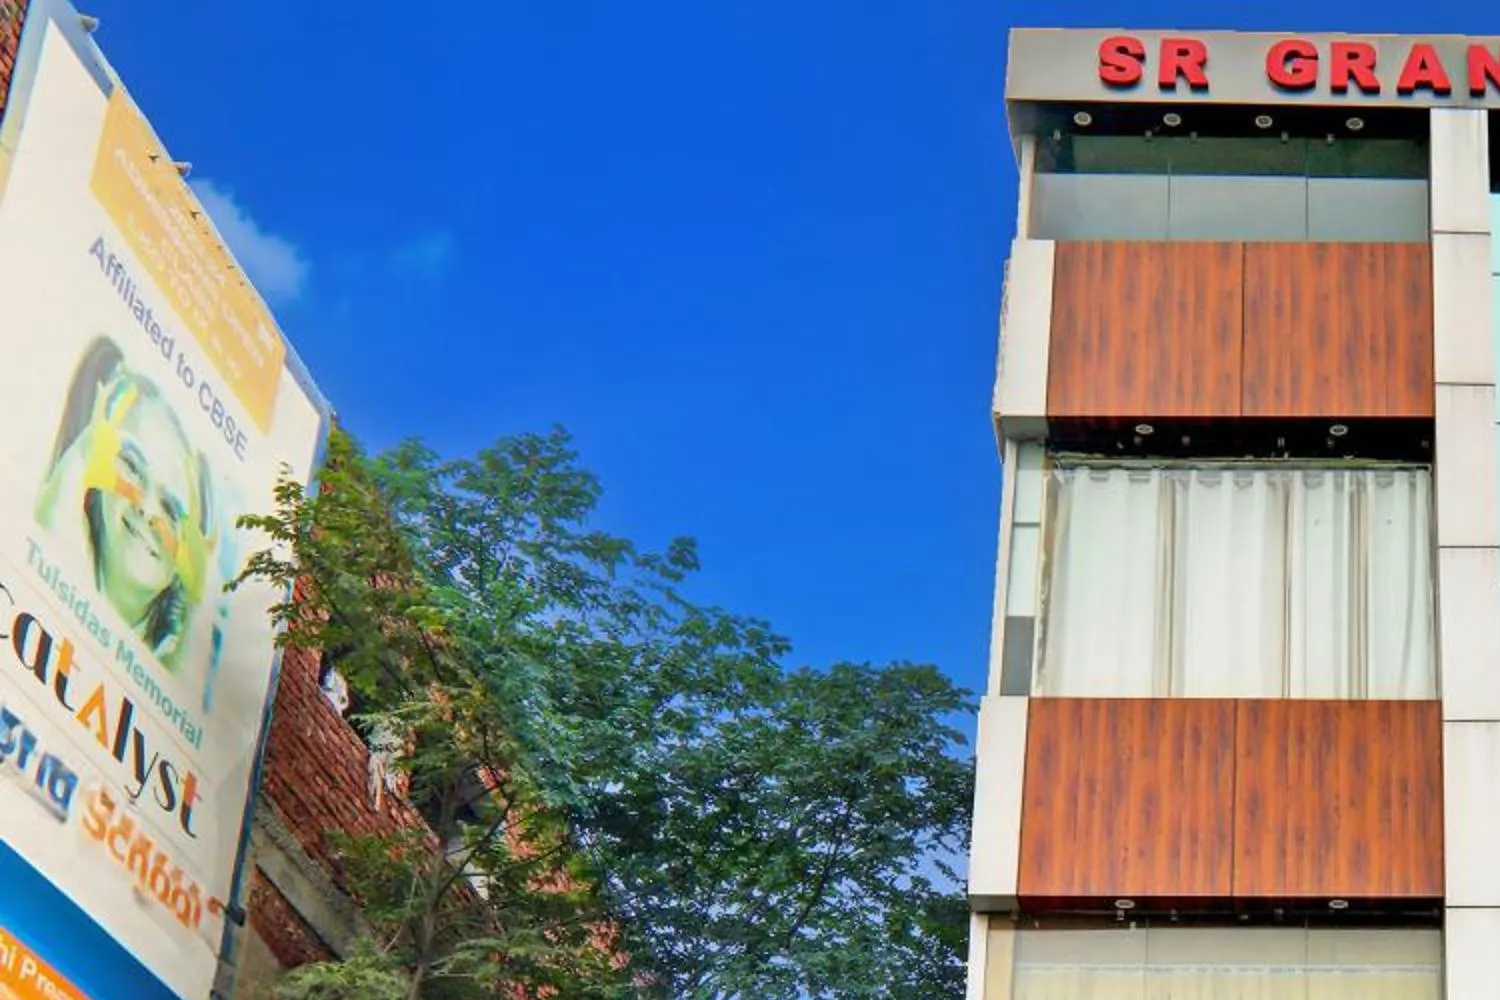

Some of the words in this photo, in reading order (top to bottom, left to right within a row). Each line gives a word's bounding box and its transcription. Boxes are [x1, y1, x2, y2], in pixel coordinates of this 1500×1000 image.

[1098, 35, 1210, 92] SR
[89, 236, 175, 362] Affiliated
[176, 352, 195, 389] to
[198, 381, 249, 463] CBSE
[0, 583, 203, 838] atAlyst
[26, 537, 112, 649] Tulsidas
[115, 639, 204, 750] Memorial
